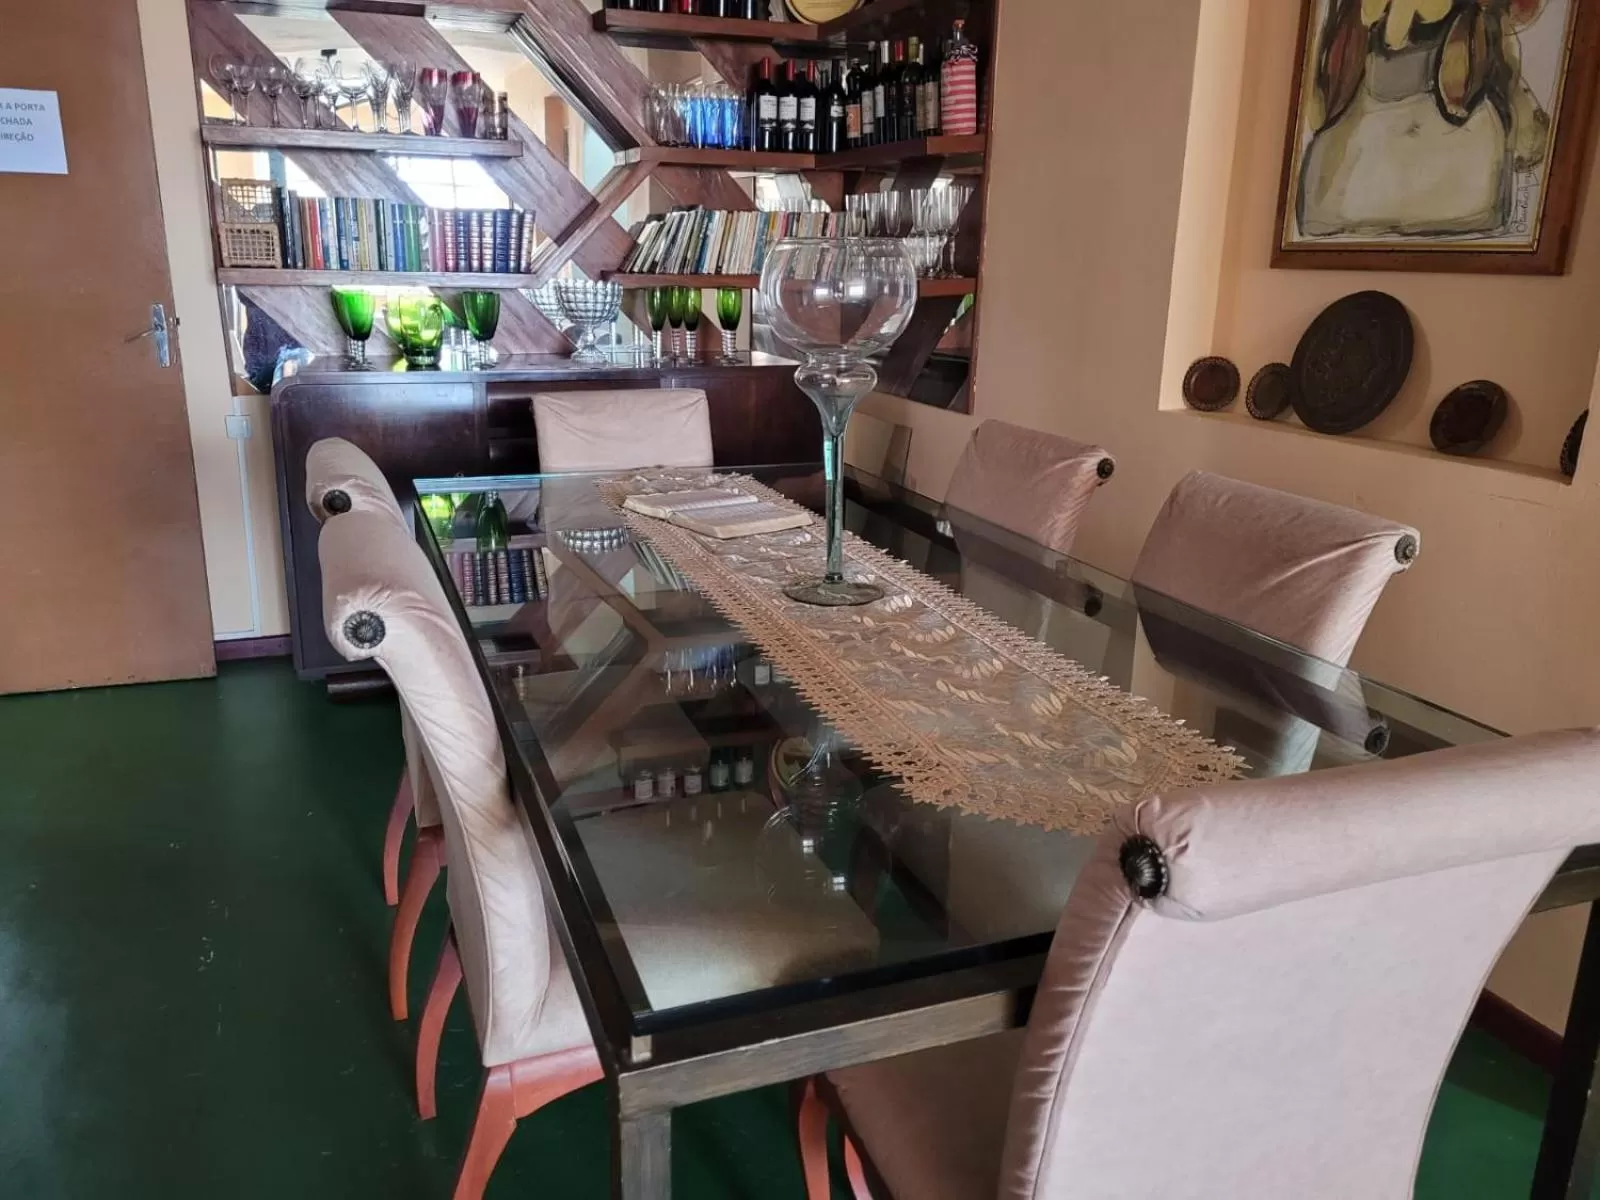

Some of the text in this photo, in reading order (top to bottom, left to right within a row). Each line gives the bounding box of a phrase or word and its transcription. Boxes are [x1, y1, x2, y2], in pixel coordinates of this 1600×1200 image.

[6, 102, 12, 110] A
[14, 102, 46, 112] PORTA
[0, 115, 33, 126] CHADA
